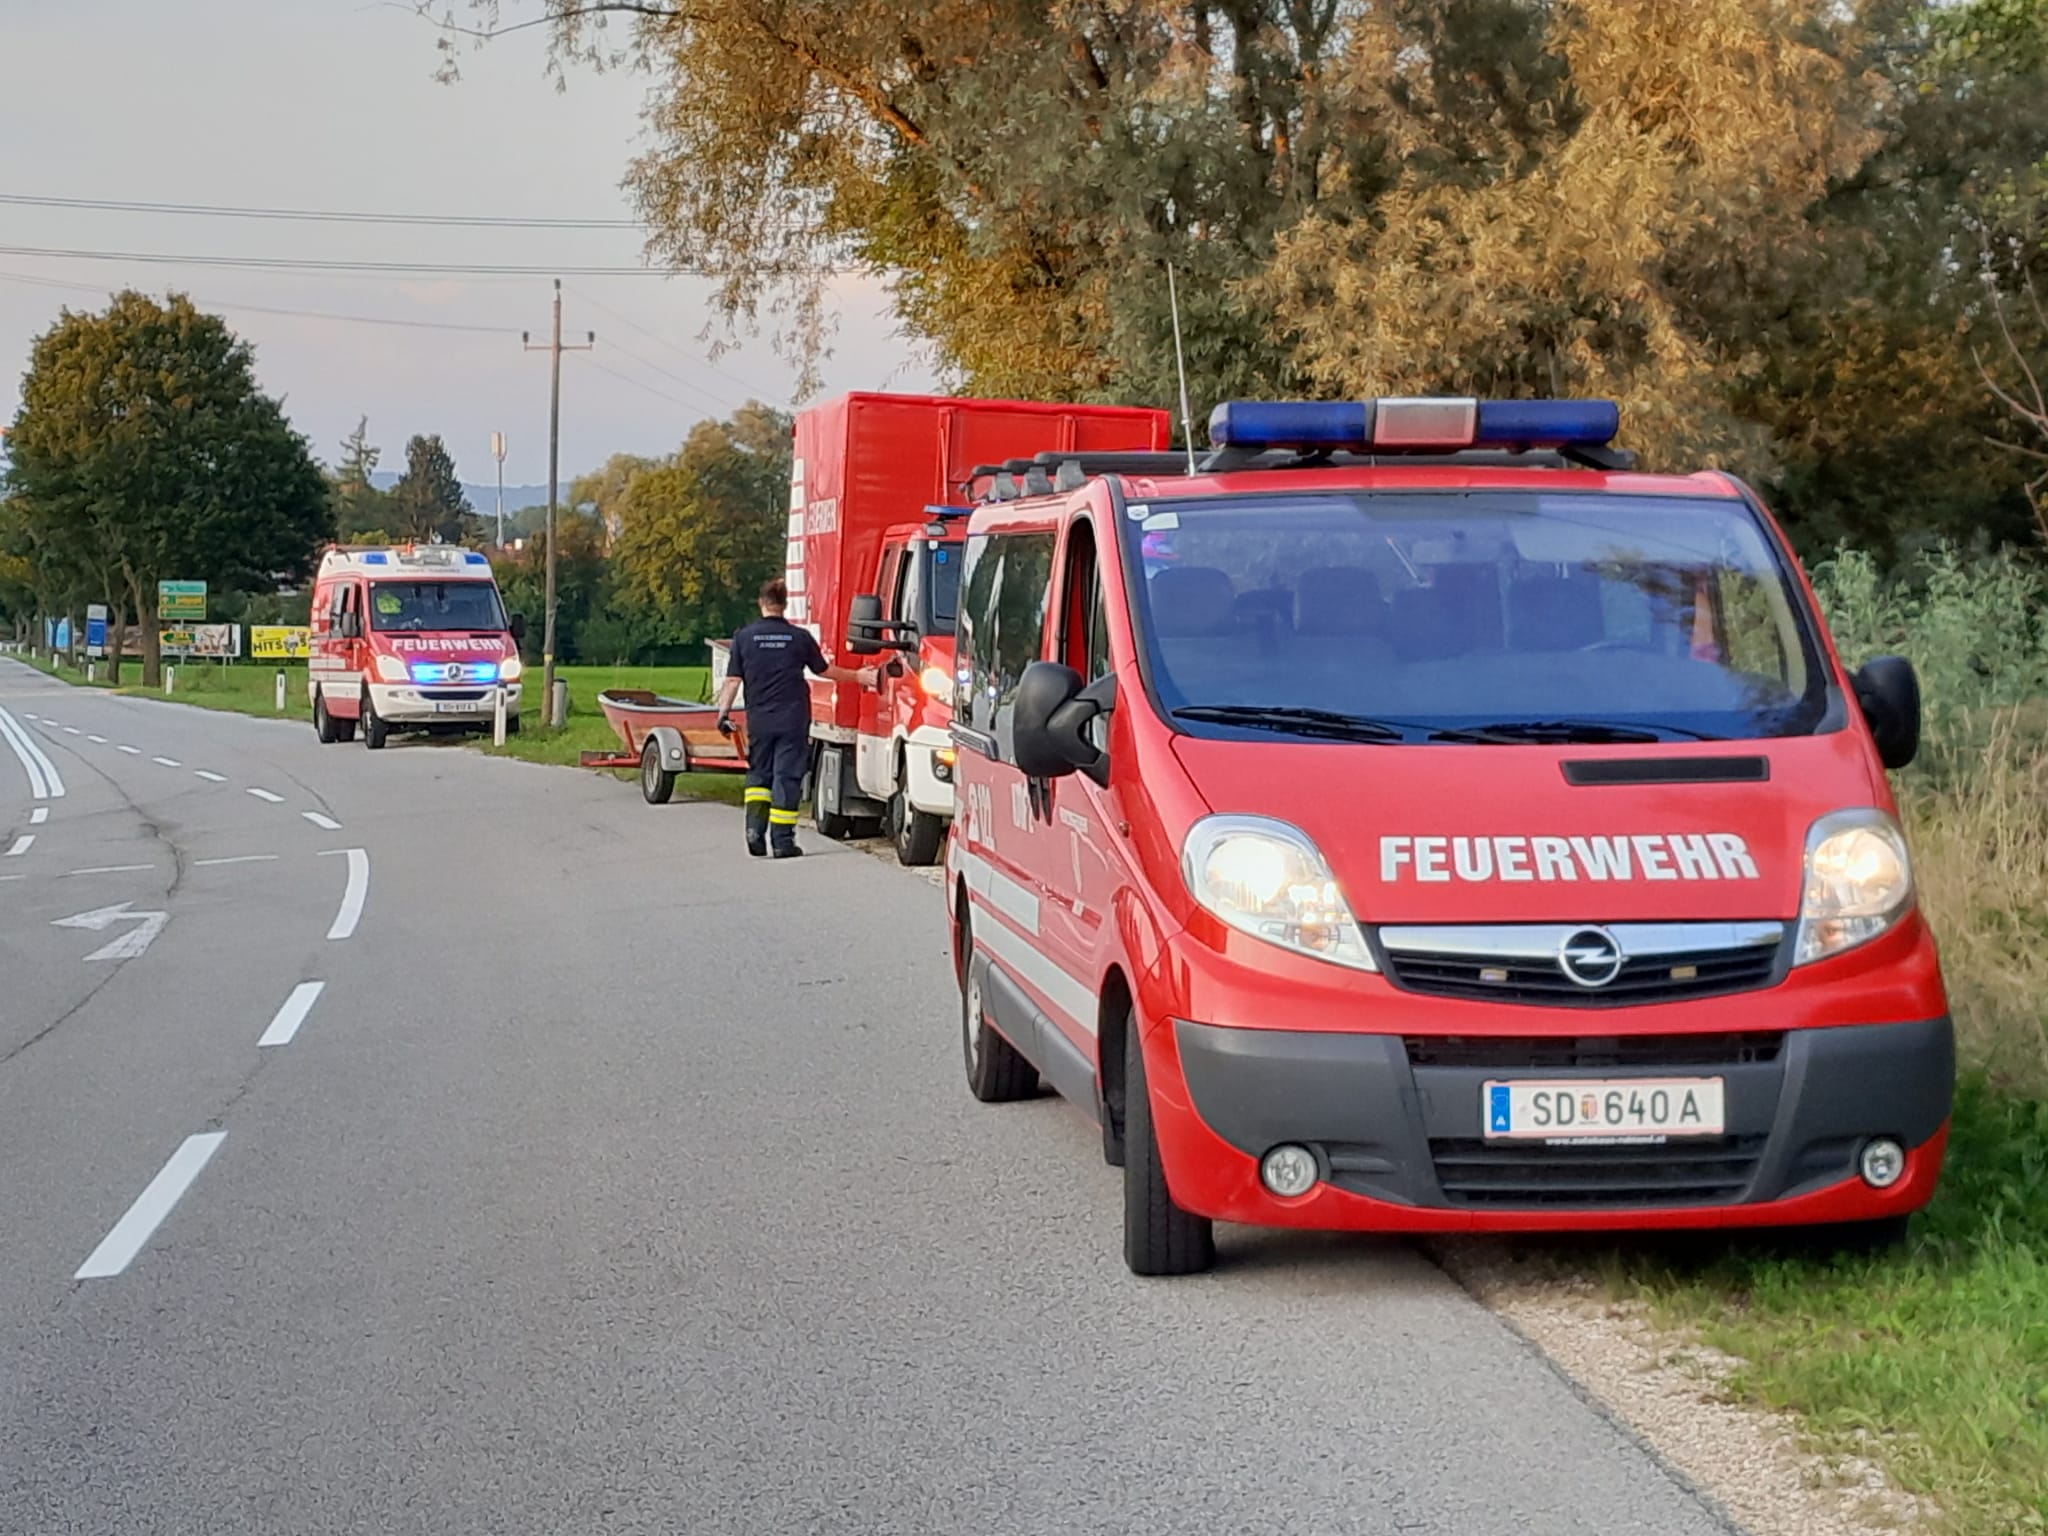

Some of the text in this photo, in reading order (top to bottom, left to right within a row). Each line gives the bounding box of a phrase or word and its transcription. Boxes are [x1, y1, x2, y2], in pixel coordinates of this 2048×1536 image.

[254, 636, 283, 652] HITS
[392, 638, 505, 652] FEUERWEHR
[1380, 833, 1760, 882] FEUERWEHR
[1532, 1089, 1702, 1126] SD 640 A
